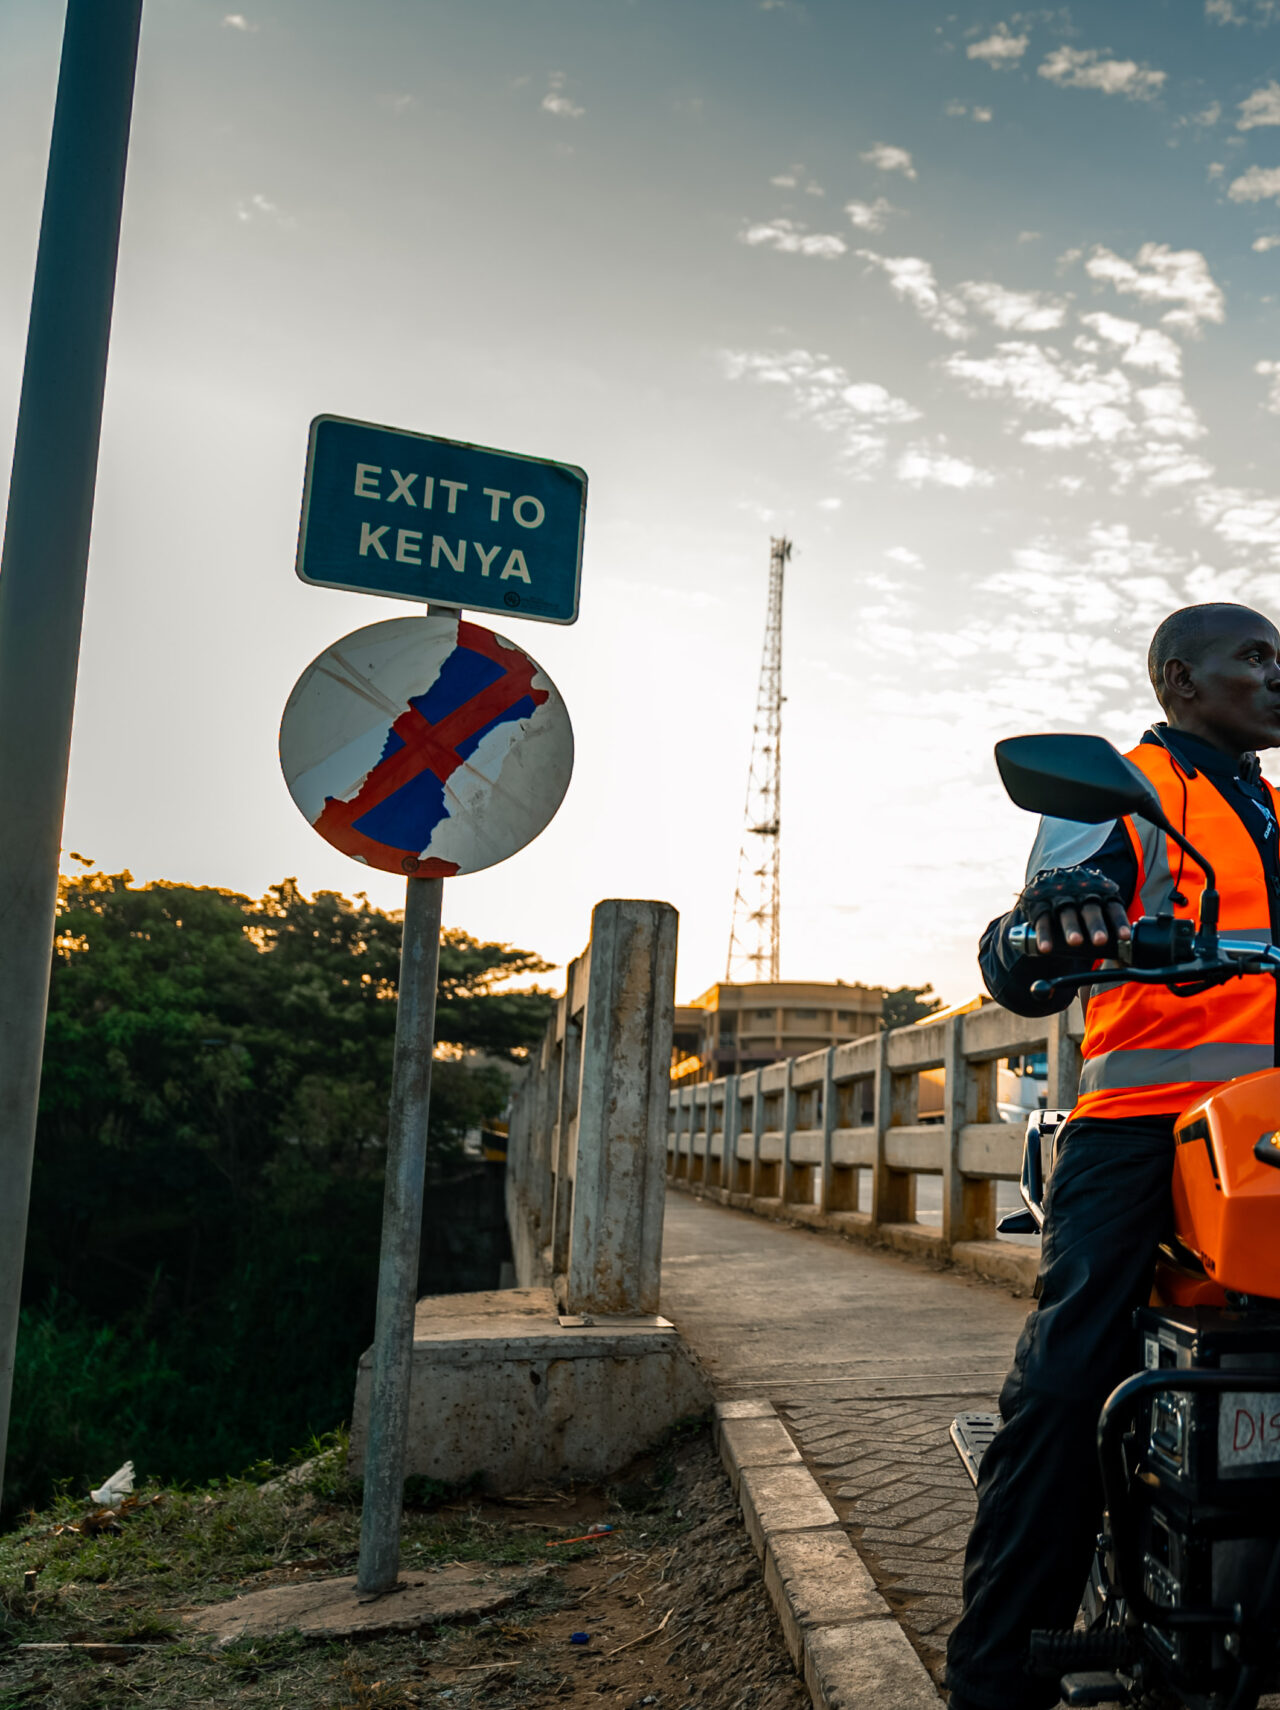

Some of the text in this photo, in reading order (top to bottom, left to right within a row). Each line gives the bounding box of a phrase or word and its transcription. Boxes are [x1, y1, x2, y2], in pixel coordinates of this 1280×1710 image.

[354, 463, 546, 529] EXIT TO
[359, 522, 532, 584] KENYA
